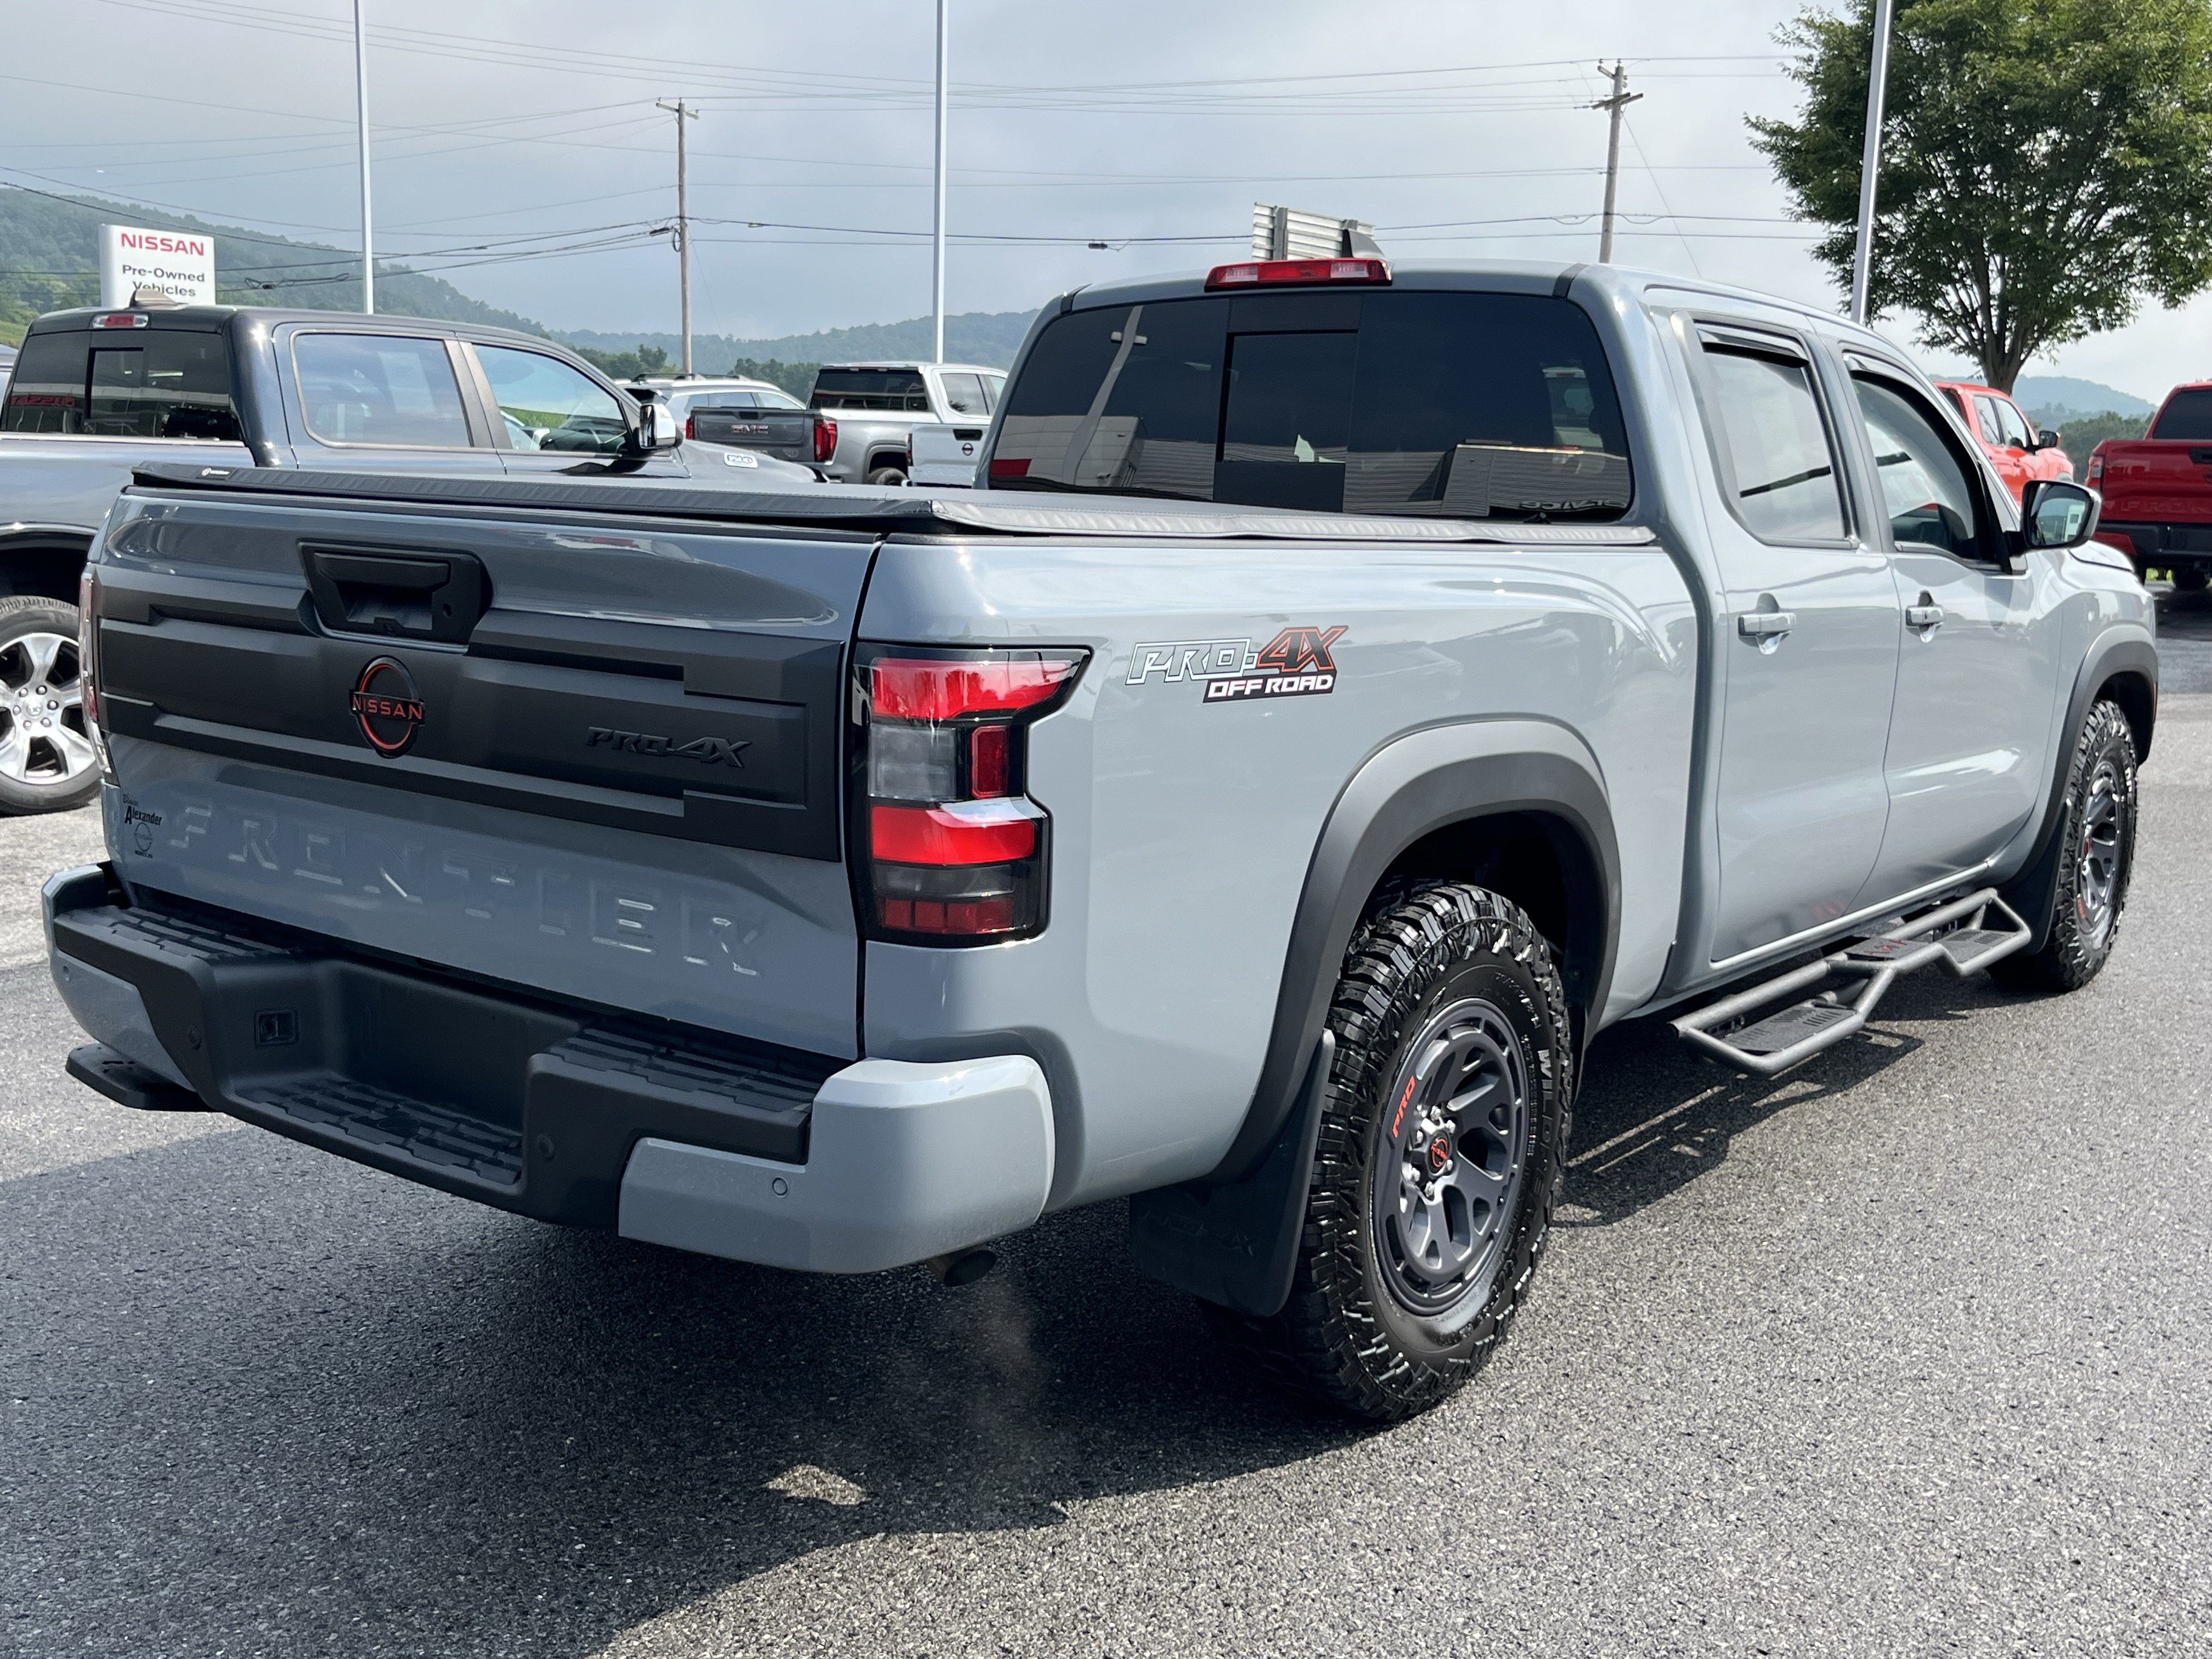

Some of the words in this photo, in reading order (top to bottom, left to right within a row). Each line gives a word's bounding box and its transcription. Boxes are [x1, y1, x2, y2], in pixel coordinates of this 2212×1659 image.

[121, 233, 205, 256] NISSAN
[122, 264, 205, 283] Pre-Owned
[132, 281, 196, 297] Vehicles
[731, 424, 769, 435] GMC
[1125, 625, 1350, 686] PRO-4X
[1207, 678, 1263, 698] OFF
[1264, 674, 1335, 694] ROAD
[352, 694, 423, 720] NISSAN
[124, 805, 162, 826] Alexander
[1392, 1075, 1417, 1138] PRO
